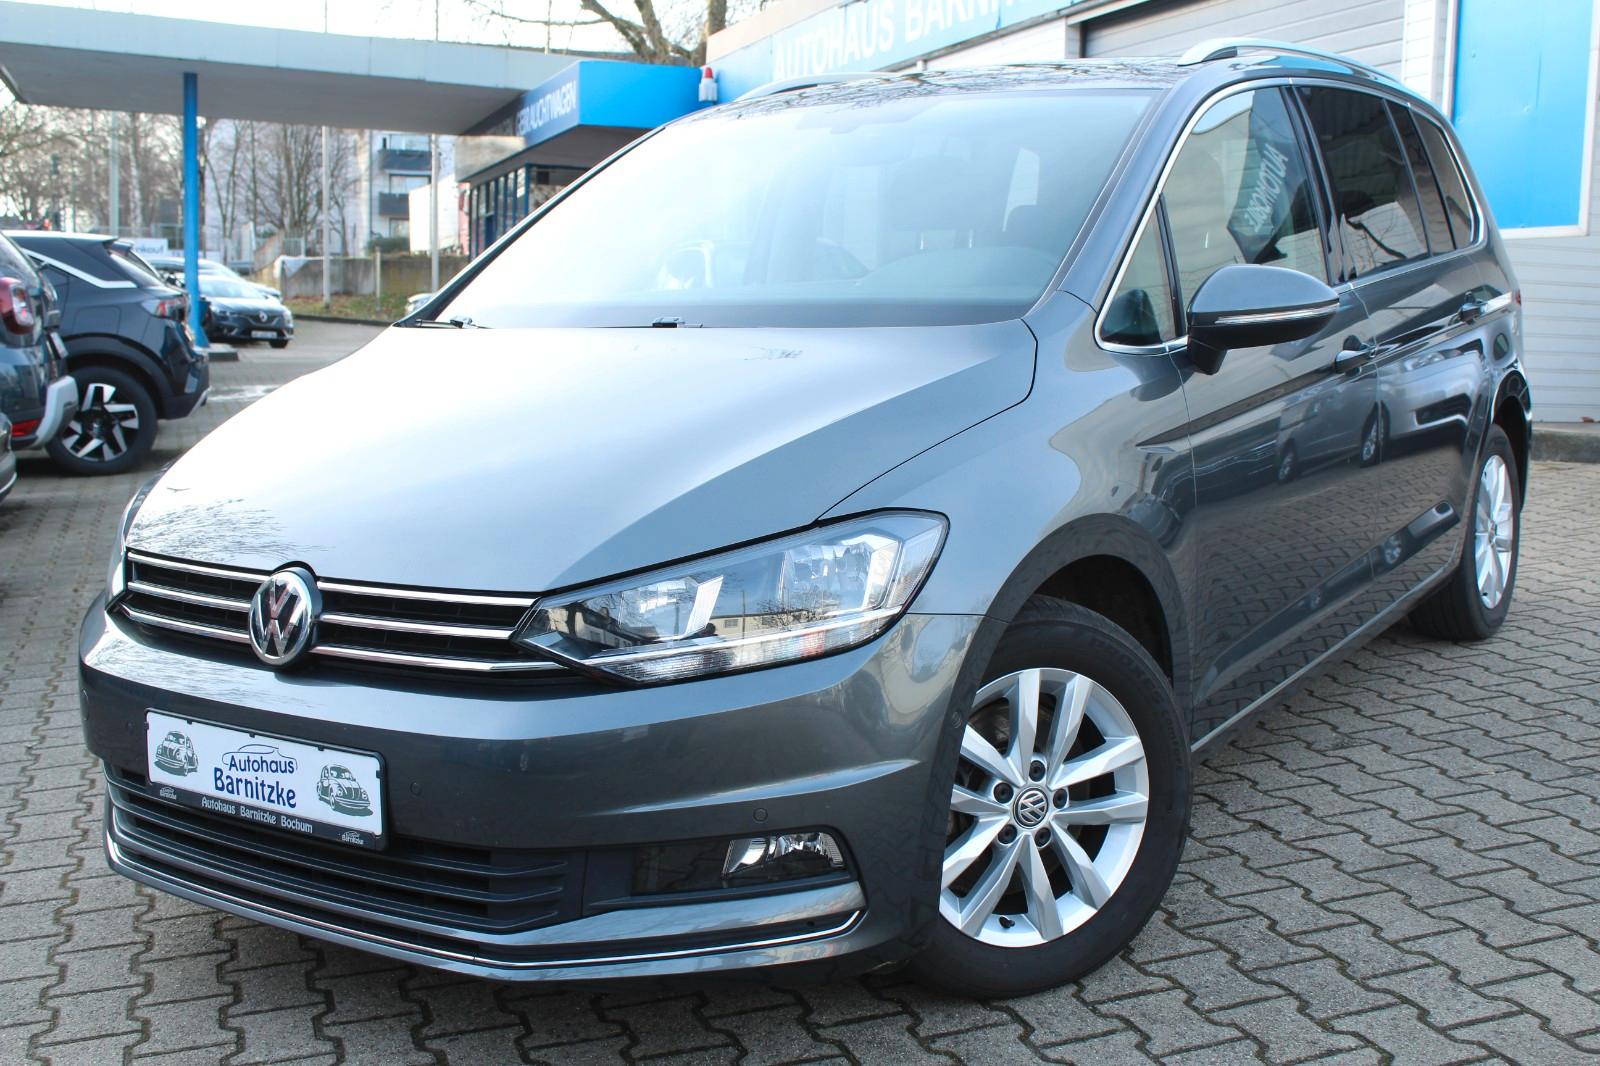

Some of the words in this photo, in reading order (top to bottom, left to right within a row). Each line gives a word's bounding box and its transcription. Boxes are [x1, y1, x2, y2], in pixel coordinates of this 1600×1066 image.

[774, 0, 897, 81] AUTOHAUS
[228, 754, 296, 775] Autohaus
[213, 767, 297, 809] Barnitzke
[201, 796, 236, 815] Autohaus
[240, 806, 277, 825] Barnitzke
[280, 816, 313, 834] Bochum
